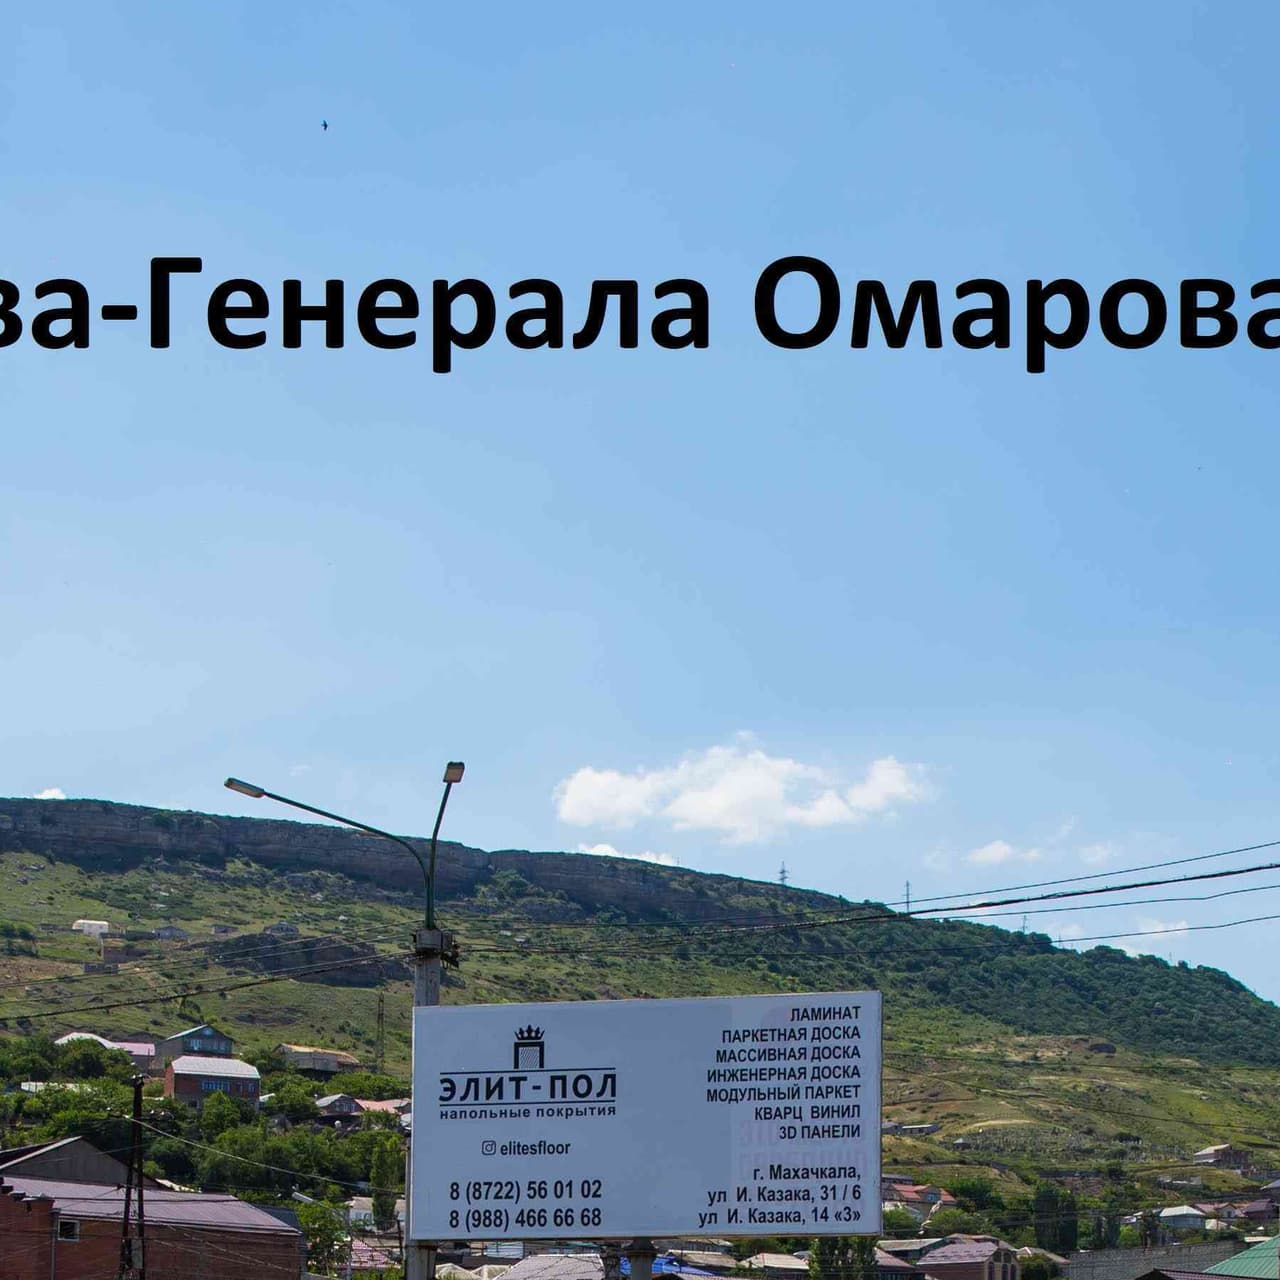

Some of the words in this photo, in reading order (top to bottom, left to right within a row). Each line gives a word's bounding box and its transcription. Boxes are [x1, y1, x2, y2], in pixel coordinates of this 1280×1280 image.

[790, 1006, 861, 1021] ЛАМИНАТ
[722, 1027, 807, 1043] ПАРКЕТНАЯ
[811, 1026, 861, 1042] ДОСКА
[716, 1047, 807, 1063] МАССИВНАЯ
[811, 1046, 861, 1062] ДОСКА
[707, 1066, 807, 1083] ИНЖЕНЕРНАЯ
[811, 1065, 861, 1082] ДОСКА
[707, 1084, 801, 1104] МОДУЛЬНЫЙ
[805, 1085, 861, 1100] ПАРКЕТ
[440, 1107, 530, 1120] напольные
[536, 1105, 616, 1120] покрытия
[755, 1106, 803, 1122] КВАРЦ
[810, 1105, 861, 1119] ВИНИЛ
[779, 1126, 797, 1140] 3D
[801, 1125, 861, 1140] ПАНЕЛИ
[500, 1140, 571, 1156] elitesfloor
[753, 1168, 764, 1181] г.
[769, 1164, 861, 1182] Махачкала,
[450, 1182, 460, 1200] 8
[466, 1181, 521, 1204] (8722)
[527, 1180, 548, 1200] 56
[554, 1180, 573, 1199] 01
[581, 1180, 602, 1199] 02
[707, 1191, 727, 1206] ул
[736, 1187, 752, 1202] И.
[757, 1186, 815, 1204] Казака,
[820, 1185, 837, 1201] 31
[852, 1185, 861, 1200] 6
[449, 1210, 460, 1228] 8
[466, 1209, 509, 1232] (988)
[515, 1209, 548, 1228] 466
[554, 1208, 575, 1227] 66
[581, 1208, 602, 1226] 68
[698, 1212, 718, 1228] ул
[727, 1209, 743, 1224] И.
[748, 1207, 806, 1225] Казака,
[811, 1206, 829, 1222] 14
